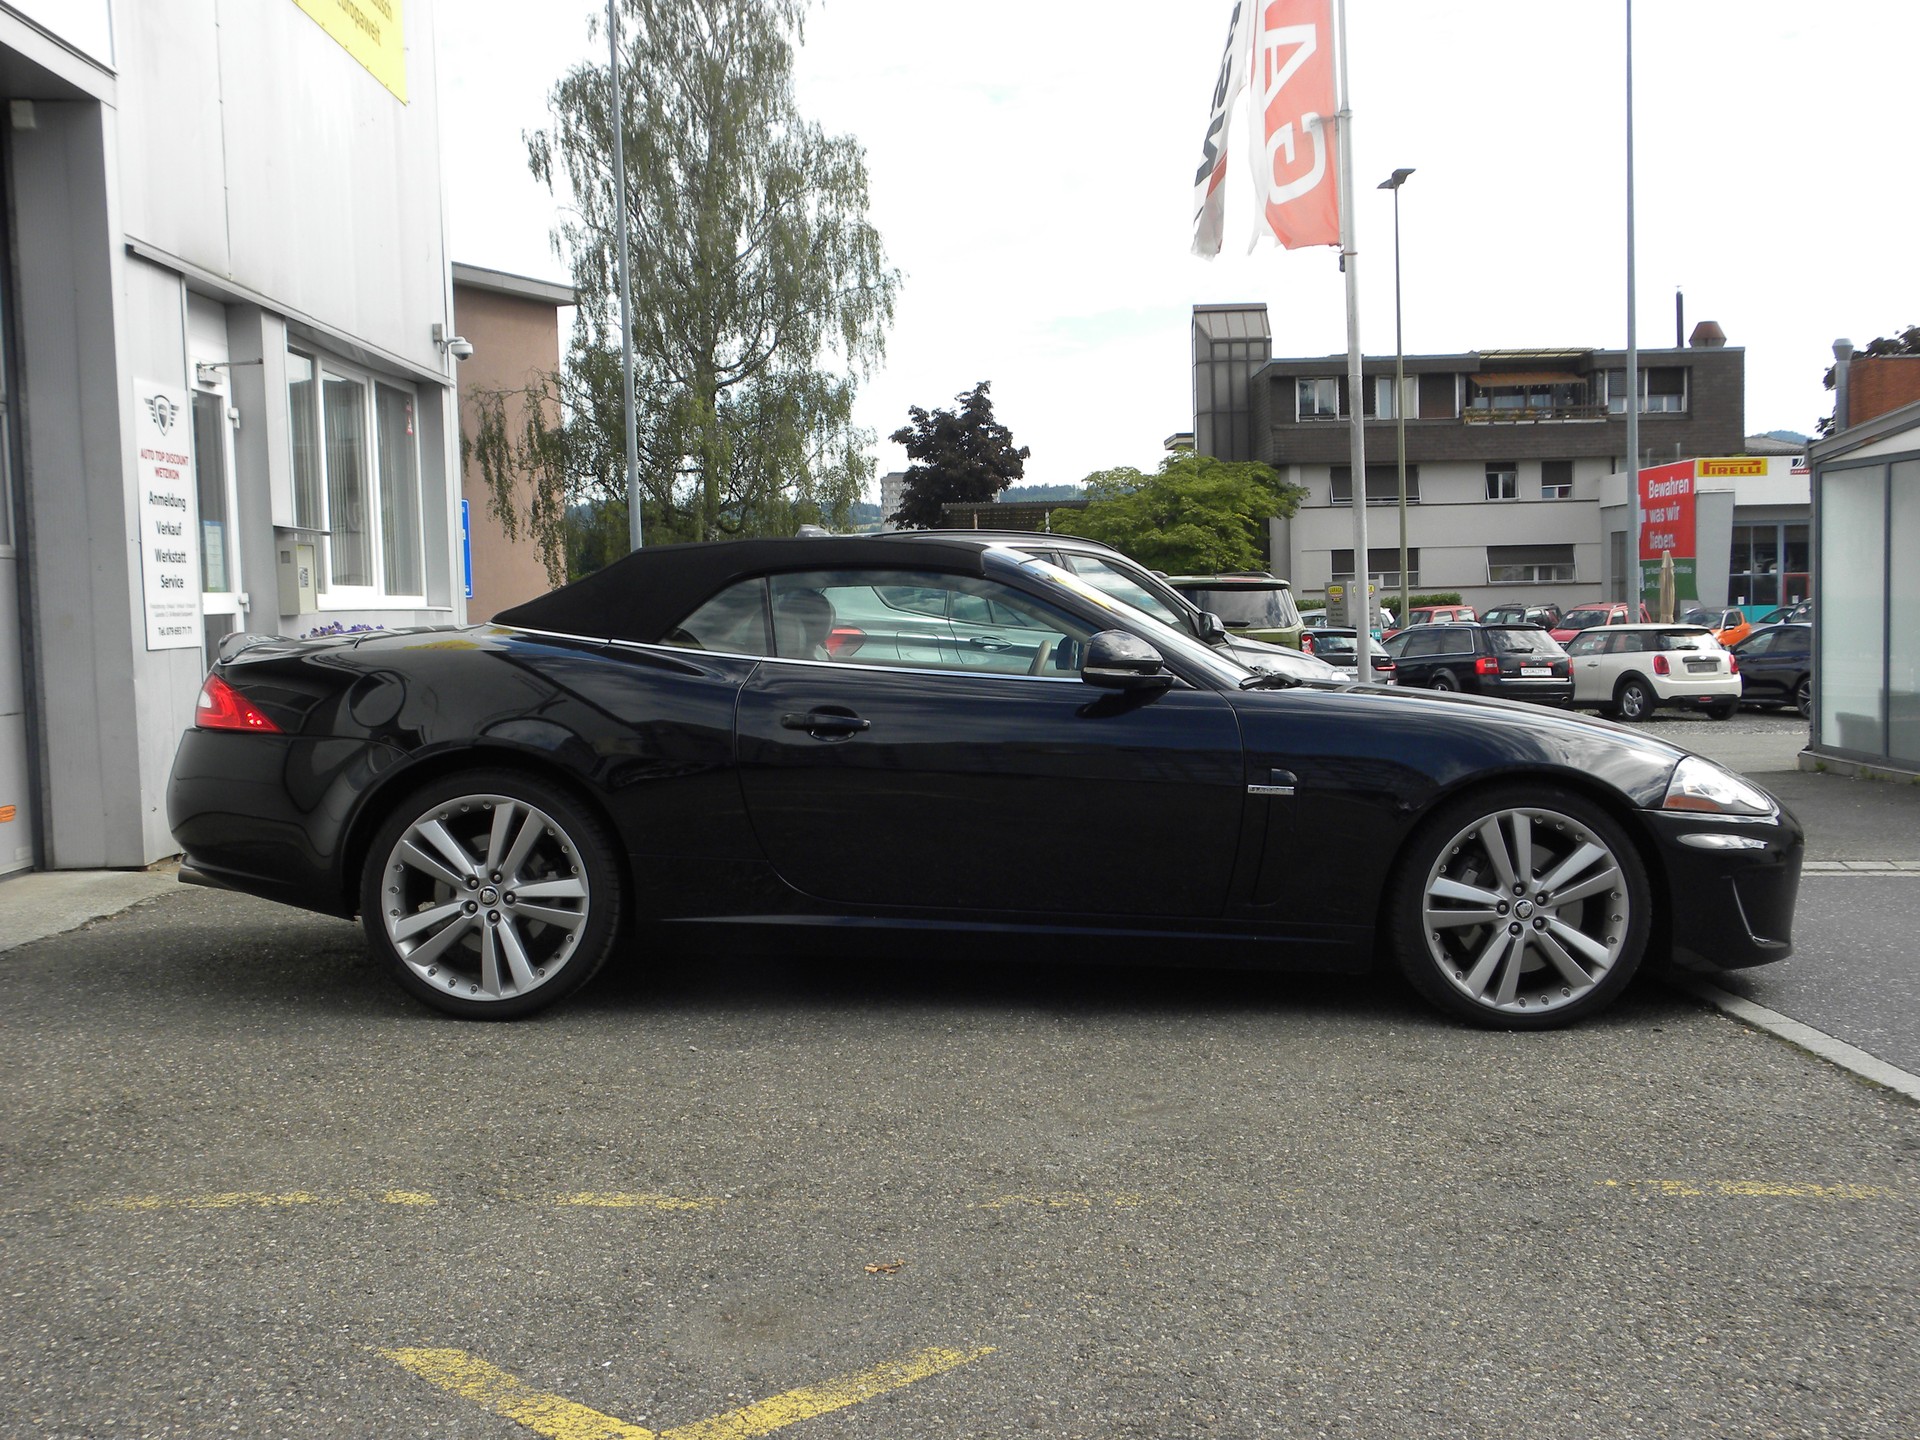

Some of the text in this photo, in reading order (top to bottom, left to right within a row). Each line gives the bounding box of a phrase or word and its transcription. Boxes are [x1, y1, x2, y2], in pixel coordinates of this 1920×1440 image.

[141, 448, 189, 466] AUTO TOP DISCOUNT
[154, 467, 180, 480] WETZIKON
[1703, 460, 1762, 475] PIRELLI
[1648, 476, 1690, 499] Bewahren
[148, 490, 187, 512] Anmeldung
[1649, 501, 1680, 524] was wir
[156, 520, 182, 536] Verkauf
[1649, 530, 1676, 550] lieben.
[154, 548, 187, 564] Werkstatt
[160, 574, 184, 589] Service
